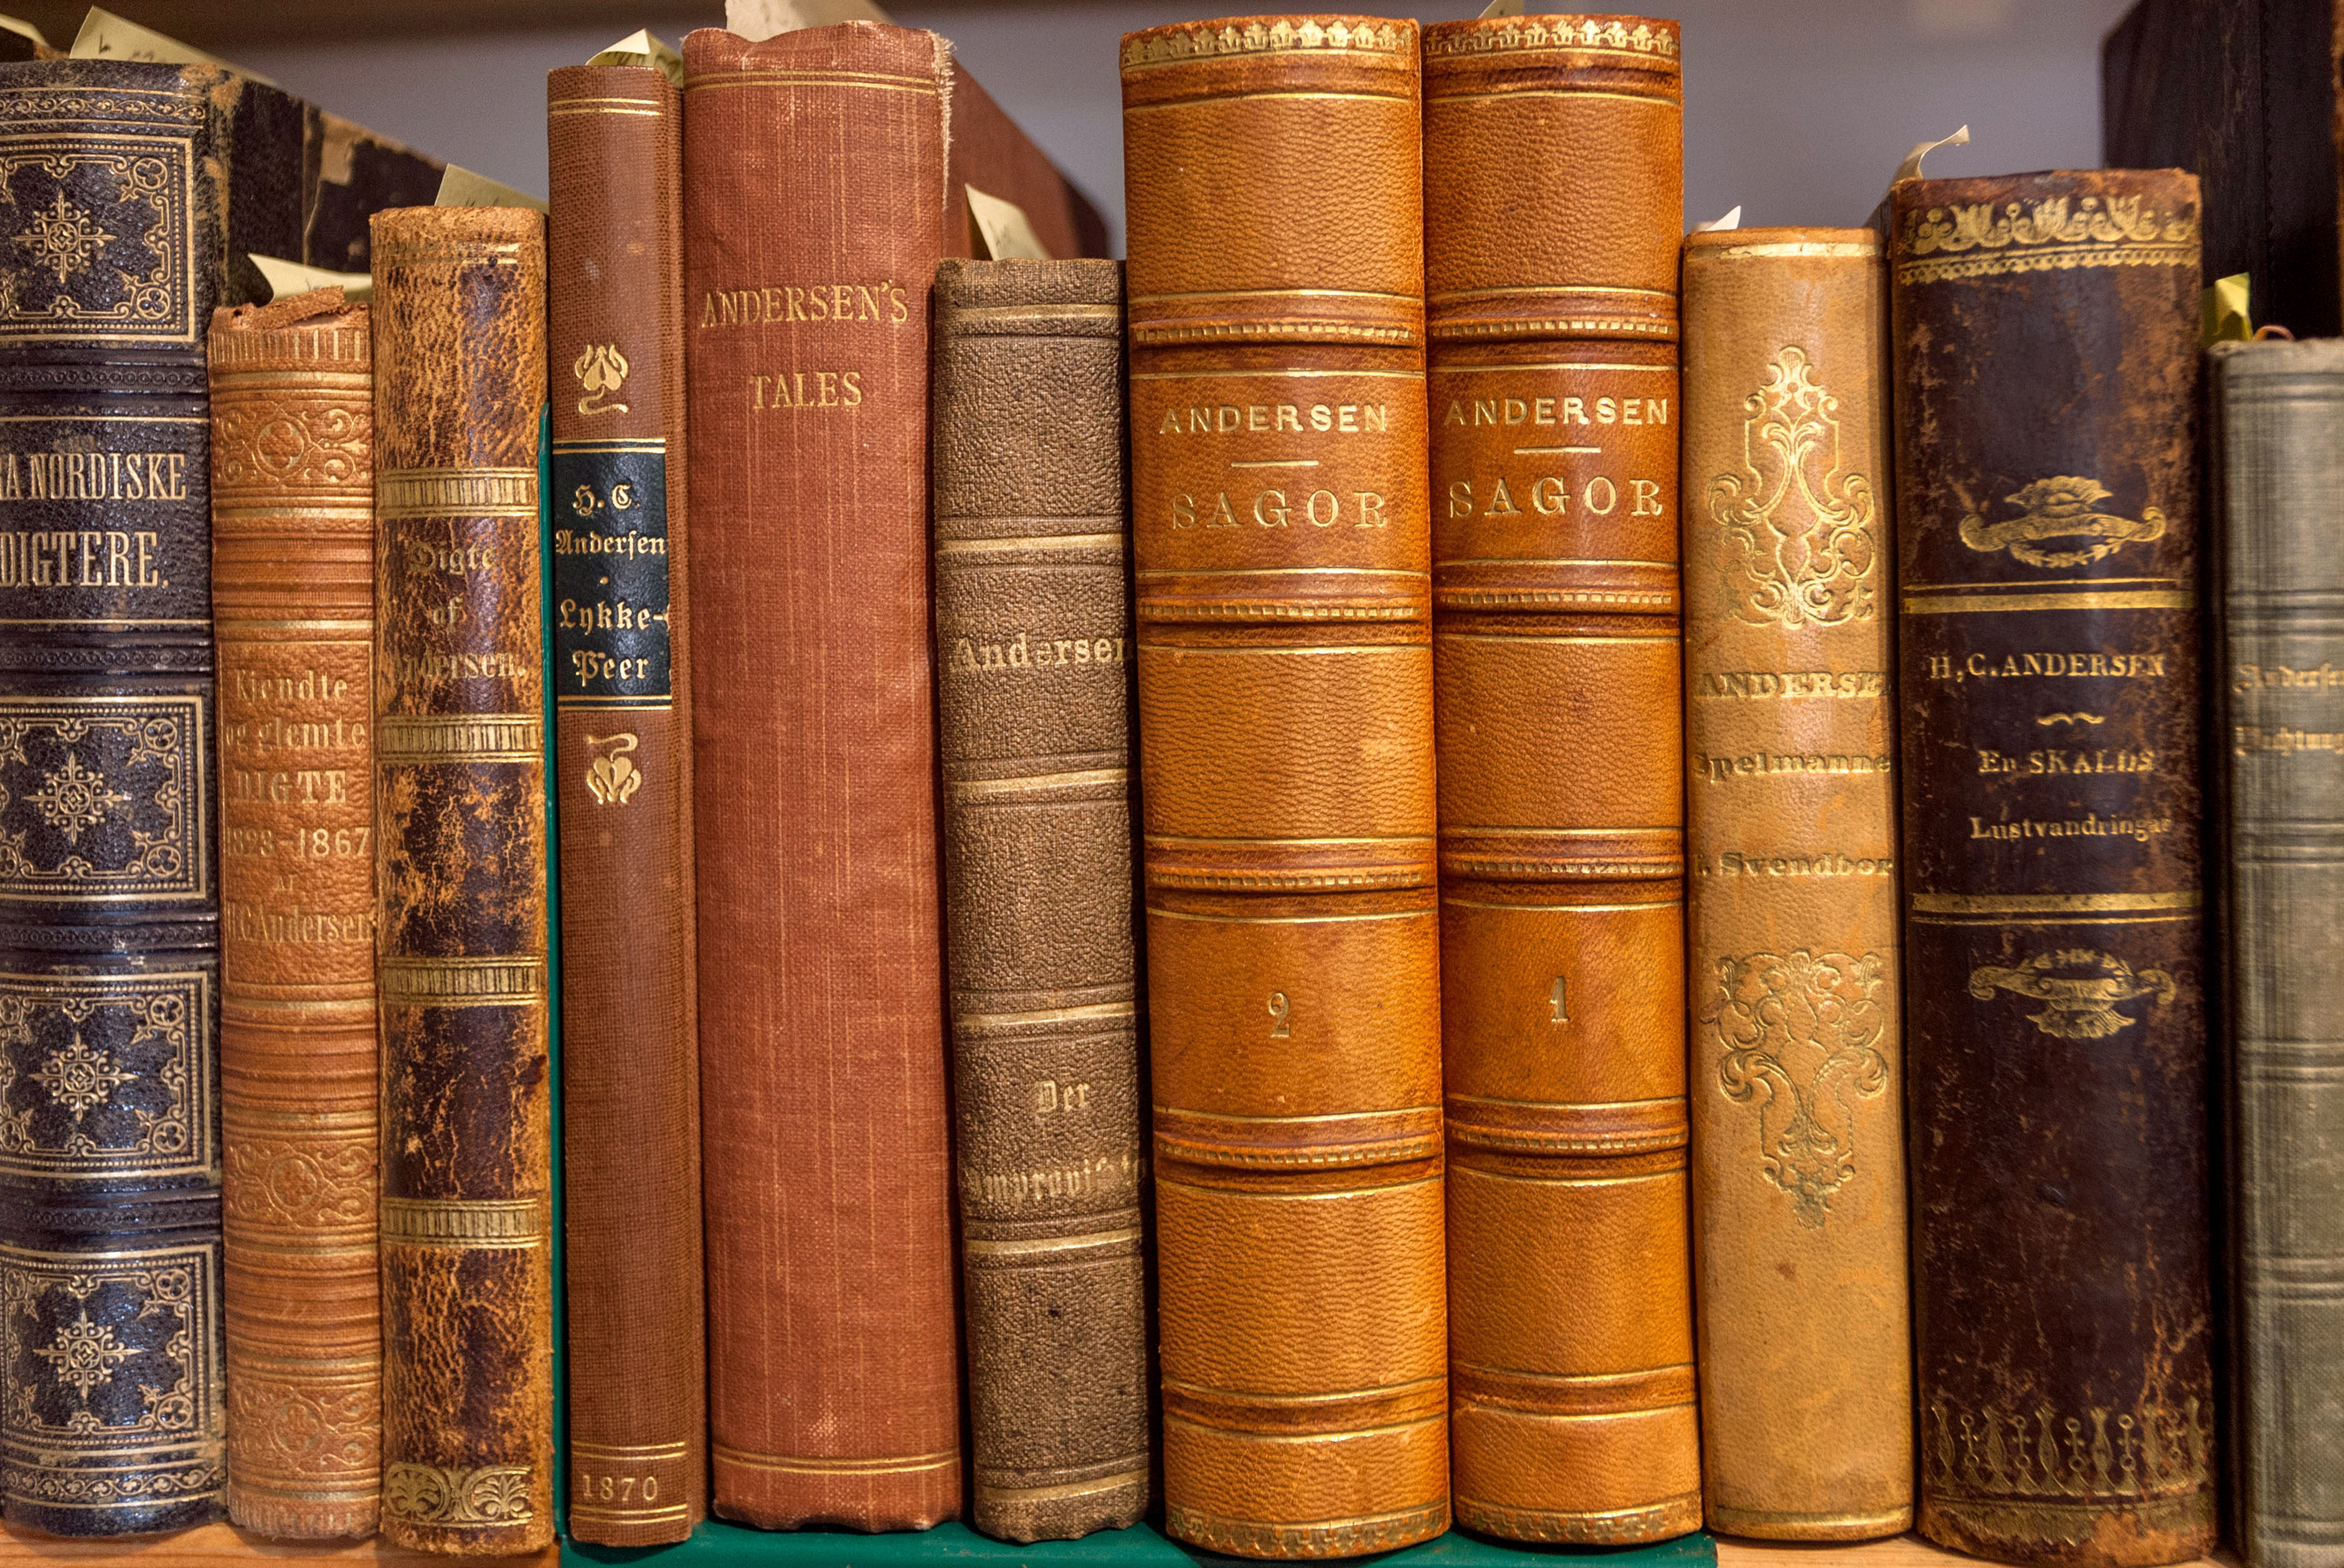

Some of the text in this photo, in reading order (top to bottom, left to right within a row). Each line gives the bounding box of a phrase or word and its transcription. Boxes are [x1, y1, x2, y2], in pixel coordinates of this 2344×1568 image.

[701, 281, 908, 328] ANDERSEN'S
[750, 372, 862, 410] TALES
[1159, 403, 1387, 434] ANDERSEN
[1444, 395, 1667, 425] ANDERSEN
[29, 453, 186, 499] NORDISKE
[572, 484, 605, 516] H.
[1173, 489, 1387, 529] SAGOR
[1449, 476, 1663, 517] SAGOR
[406, 542, 495, 574] Digte
[573, 650, 648, 686] Peer
[1694, 671, 1889, 699] ANDERSE
[1978, 749, 2017, 773] En
[1549, 975, 1569, 1023] 1
[1035, 1080, 1090, 1118] Der
[583, 1475, 658, 1501] 1870
